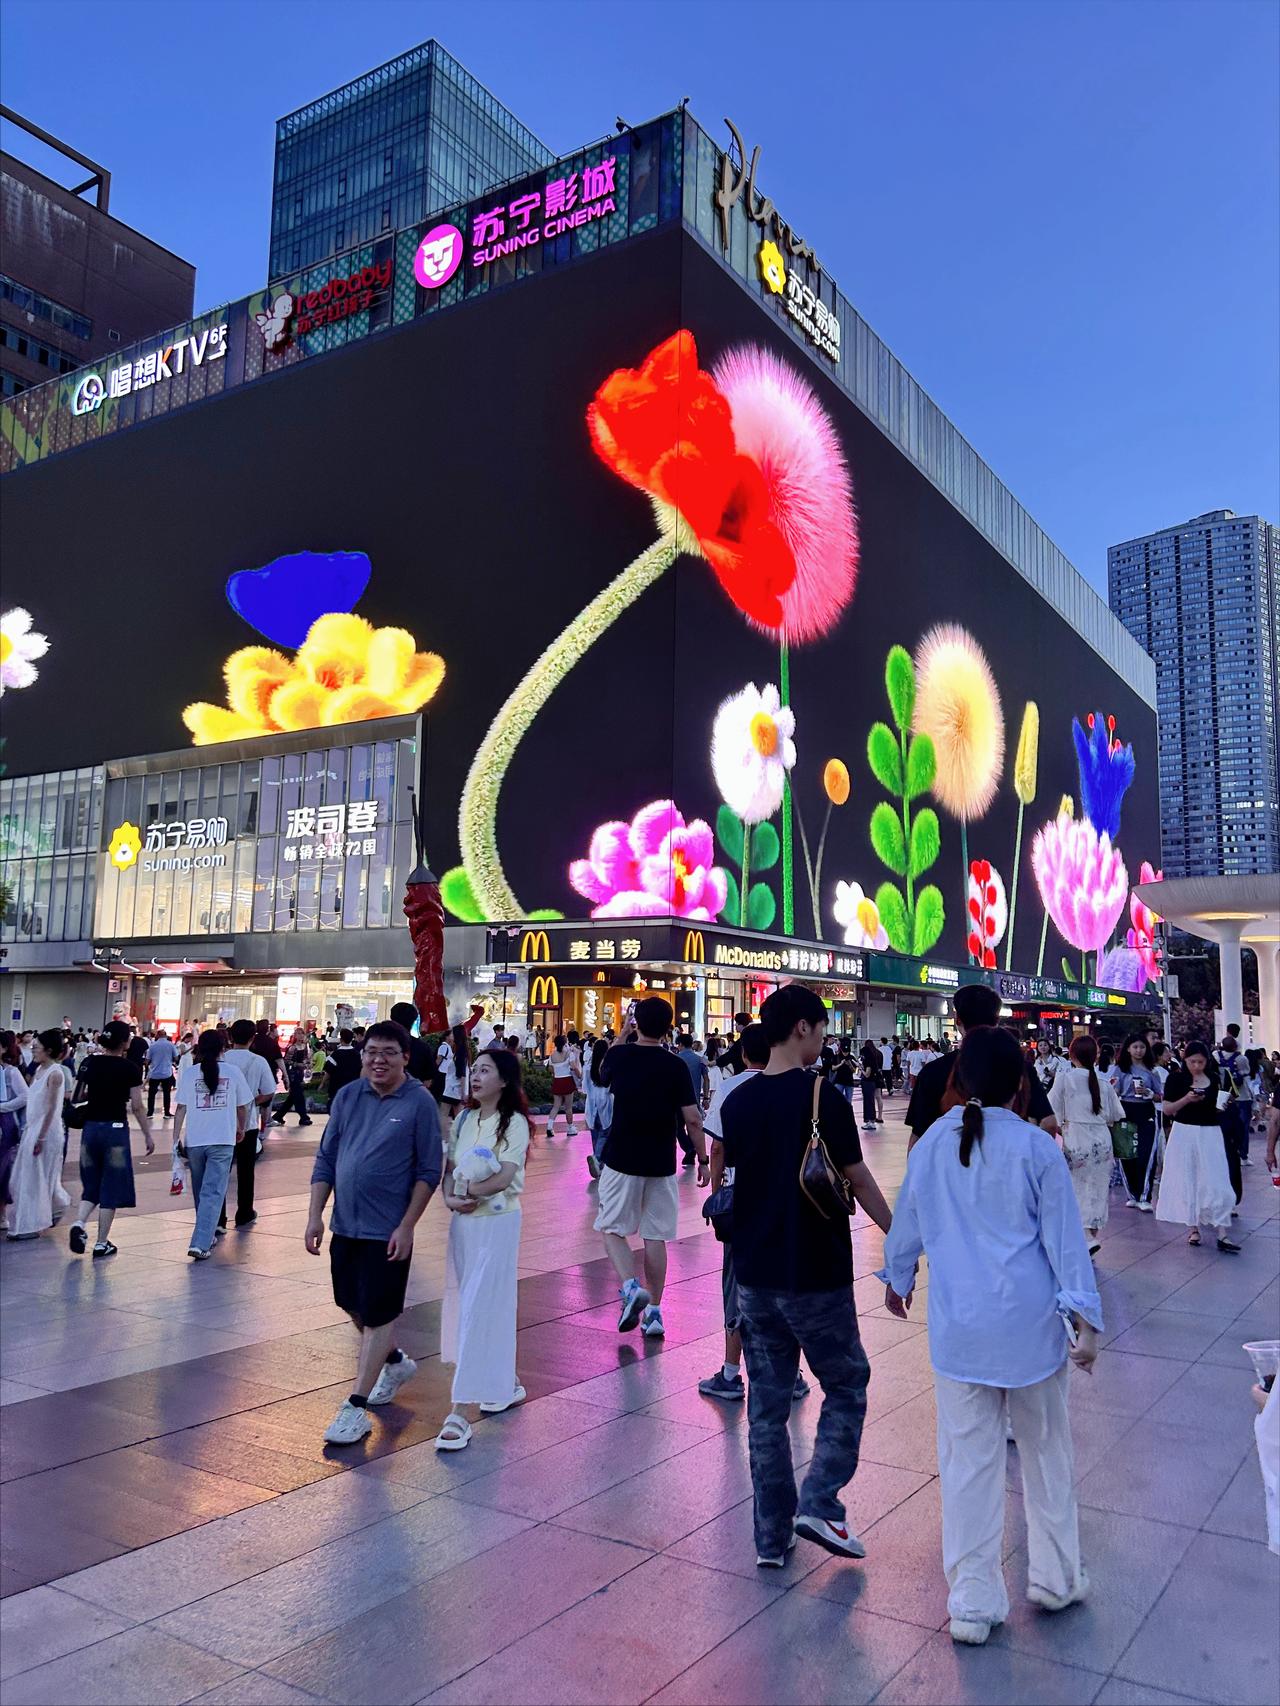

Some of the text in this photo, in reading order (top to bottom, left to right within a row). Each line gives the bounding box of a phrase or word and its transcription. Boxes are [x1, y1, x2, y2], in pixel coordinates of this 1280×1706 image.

[472, 156, 616, 247] 苏宁影城
[472, 198, 616, 267] SUNING CINEMA
[297, 258, 393, 314] redbaby
[787, 268, 841, 348] 苏宁易购
[209, 323, 228, 345] 6F
[787, 300, 841, 363] suning.com
[144, 816, 228, 853] 苏宁易购
[285, 800, 379, 839] 波司登
[143, 854, 225, 875] suning.com
[570, 938, 641, 961] 麦当劳
[715, 944, 782, 971] McDonald's
